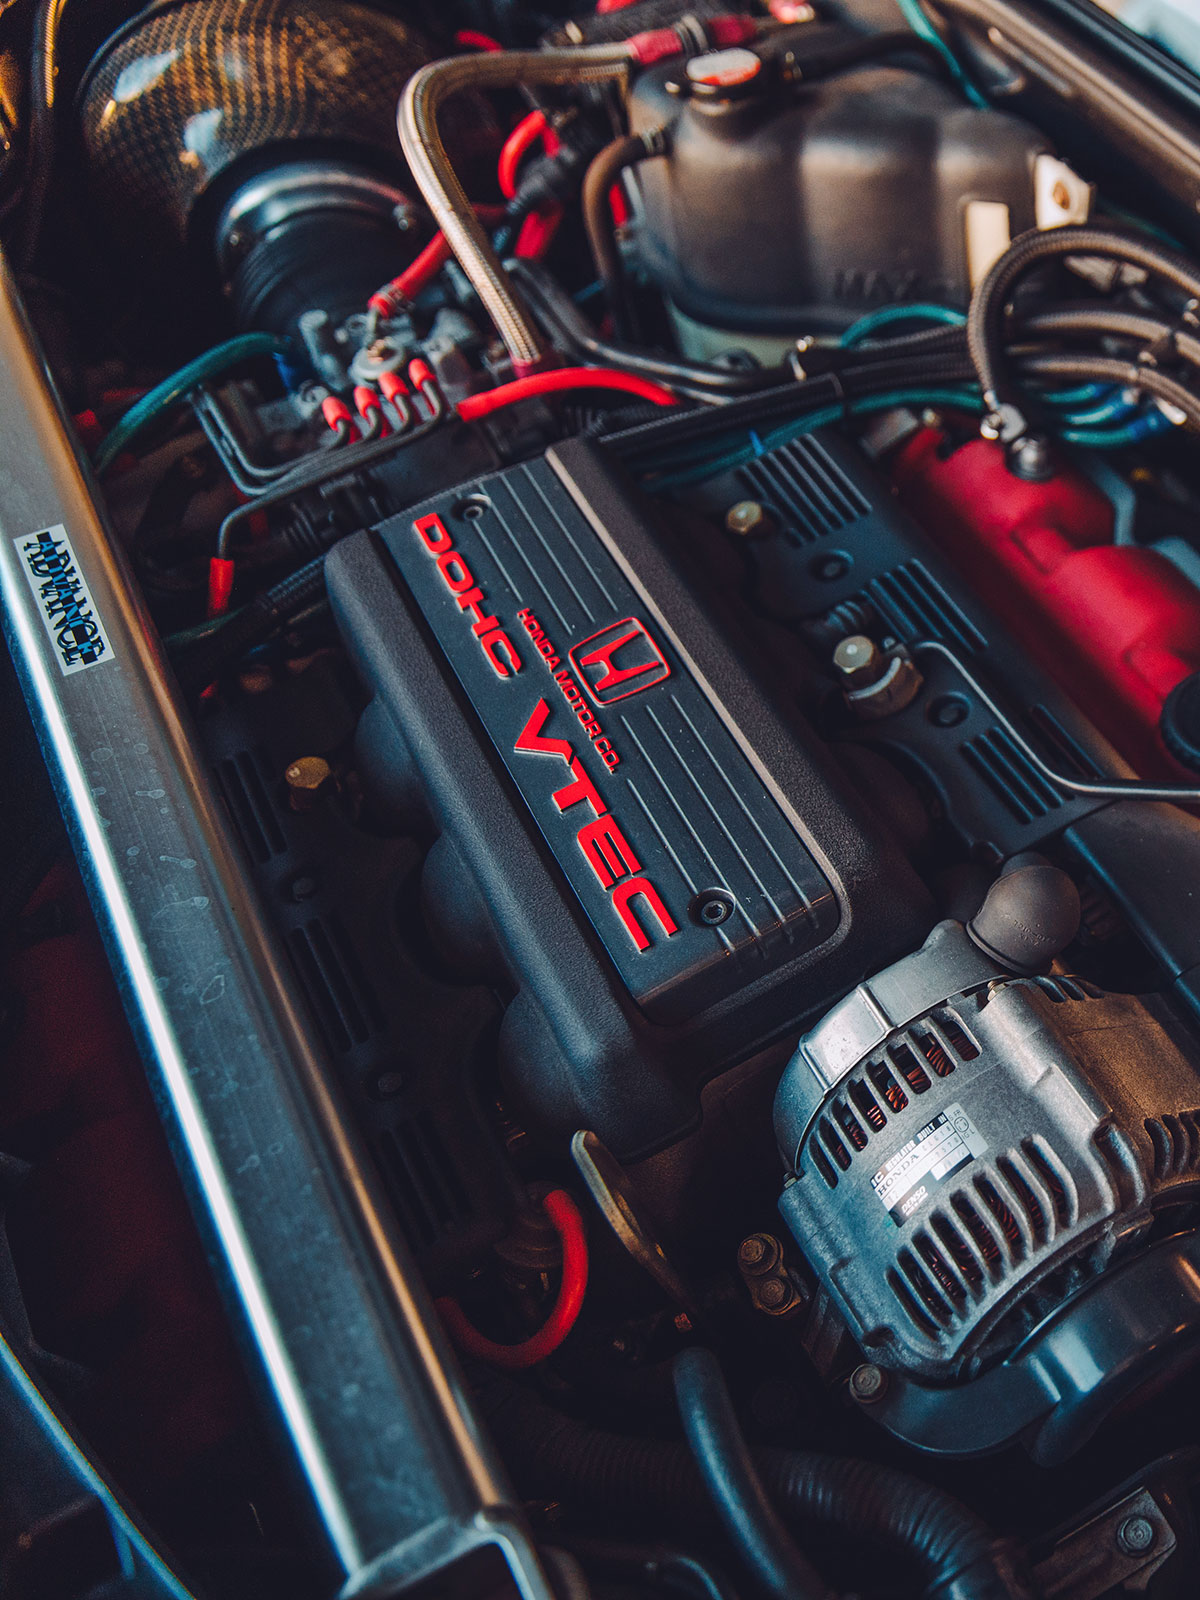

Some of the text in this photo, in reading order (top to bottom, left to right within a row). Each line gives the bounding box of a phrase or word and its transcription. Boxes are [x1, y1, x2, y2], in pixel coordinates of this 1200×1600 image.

[23, 538, 105, 666] ADVANCE
[412, 512, 679, 955] DOHC VTEC
[517, 607, 620, 775] HONDA MOTOR CO.
[917, 1122, 936, 1141] BUILT
[877, 1154, 919, 1196] HONDA
[901, 1185, 926, 1213] DENSO
